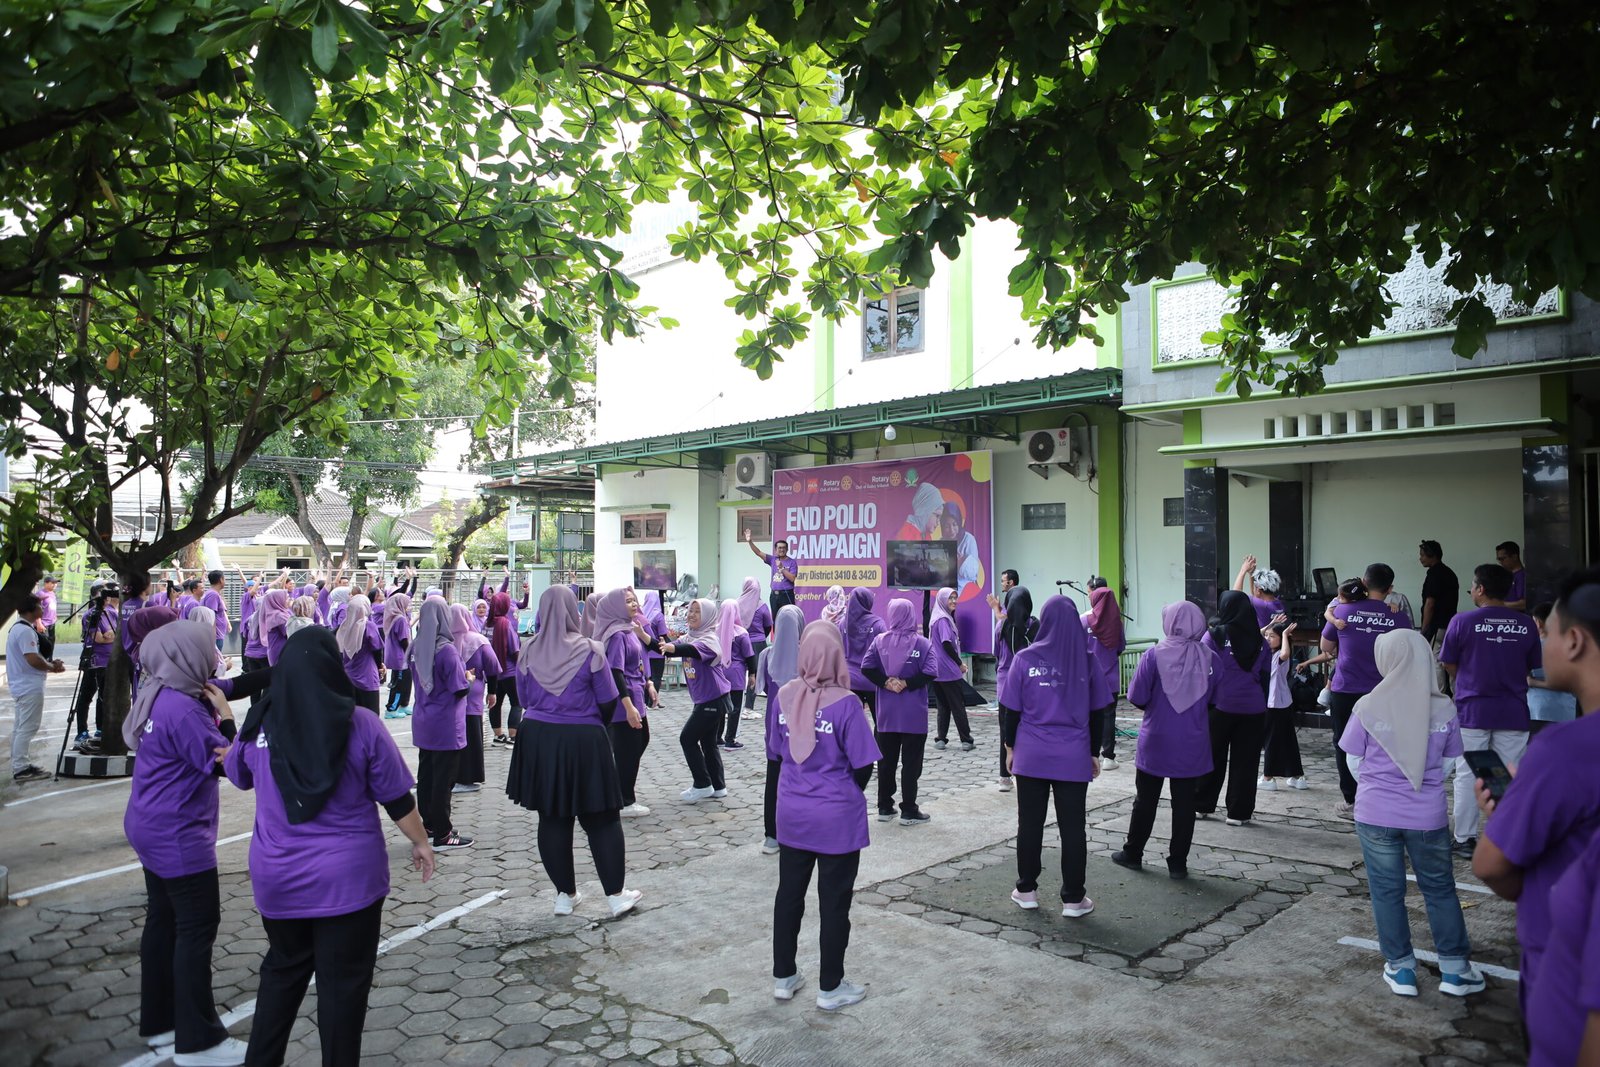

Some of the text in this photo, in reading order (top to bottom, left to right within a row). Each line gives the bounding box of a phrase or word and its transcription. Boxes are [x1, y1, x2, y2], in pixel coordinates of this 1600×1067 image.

[823, 479, 840, 487] Rotary
[871, 475, 889, 483] Rotary
[786, 502, 877, 532] END POLIO
[786, 532, 881, 560] CAMPAIGN
[810, 570, 834, 581] District
[834, 569, 851, 581] 3410
[851, 570, 858, 581] &
[858, 569, 877, 580] 3420
[794, 592, 821, 602] ogether
[1347, 615, 1395, 627] END POLIO
[1474, 624, 1528, 635] END POLIO
